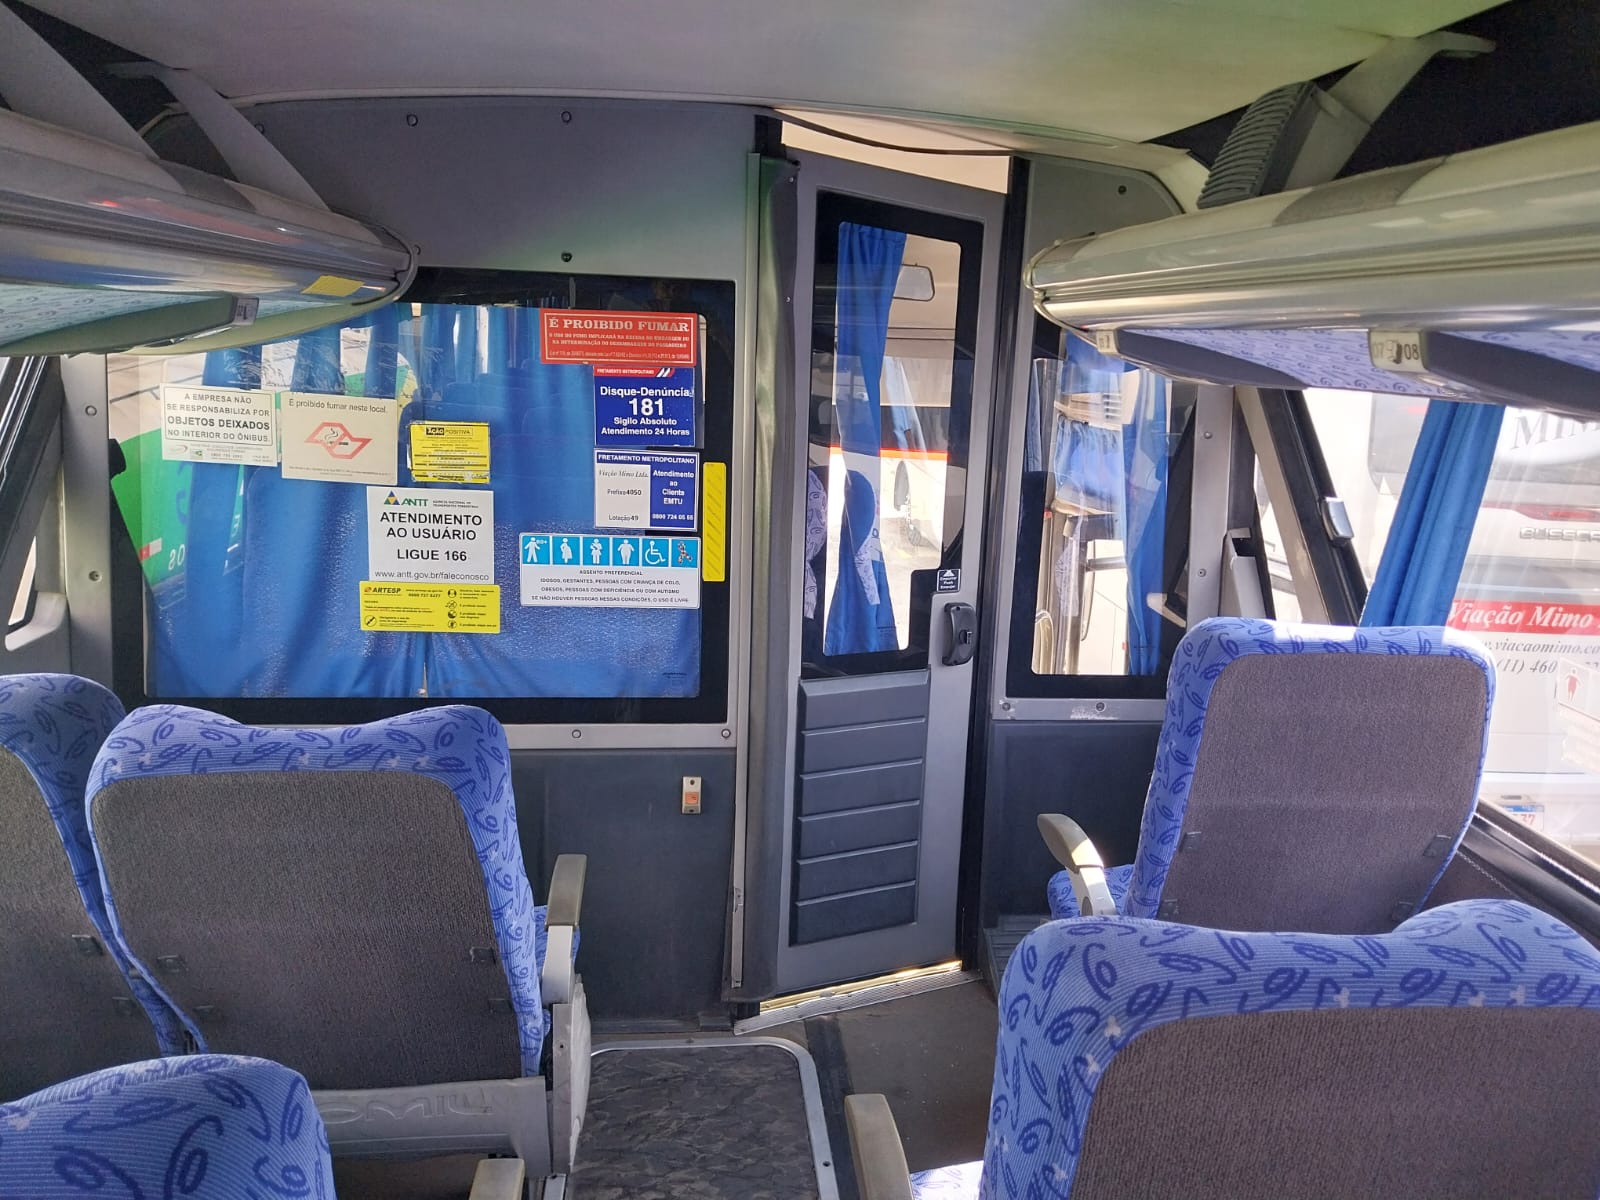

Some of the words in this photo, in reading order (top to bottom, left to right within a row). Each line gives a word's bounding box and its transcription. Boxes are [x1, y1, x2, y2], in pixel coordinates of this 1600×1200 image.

[549, 317, 559, 328] É
[562, 319, 633, 330] PROIBIDO
[637, 321, 690, 332] FUMAR
[1404, 343, 1420, 361] 08
[600, 386, 690, 398] Disque-Denúncia
[192, 394, 232, 403] EMPRESA
[234, 396, 252, 404] NÃO
[167, 403, 177, 411] SE
[180, 404, 251, 416] RESPONSABILIZA
[253, 408, 270, 417] POR
[296, 400, 325, 409] proibido
[326, 402, 347, 410] fumar
[348, 404, 368, 412] neste
[628, 398, 663, 416] 181
[167, 415, 215, 427] OBJETOS
[218, 419, 270, 430] DEIXADOS
[613, 417, 638, 427] Sigilo
[640, 417, 677, 425] Absoluto
[182, 430, 221, 439] INTERIOR
[223, 432, 235, 440] DO
[601, 427, 653, 435] Atendimento
[666, 428, 690, 436] Horas
[598, 454, 641, 462] FRETAMENTO
[641, 456, 695, 464] METROPOLITANO
[653, 470, 695, 478] Atendimento
[662, 488, 685, 496] Cliente
[401, 498, 429, 507] ANTT
[380, 512, 482, 526] ATENDIMENTO
[386, 527, 407, 538] AO
[412, 527, 477, 541] USUÁRIO
[1519, 527, 1600, 543] BUSSCA
[168, 543, 186, 571] 80
[397, 549, 439, 561] LIGUE
[444, 550, 467, 561] 166
[375, 571, 489, 581] www.antt.gov.br/faleconosco
[1448, 600, 1523, 628] Viação
[1526, 605, 1594, 628] Mimo
[1496, 658, 1525, 674] (11)
[1529, 660, 1559, 674] 460
